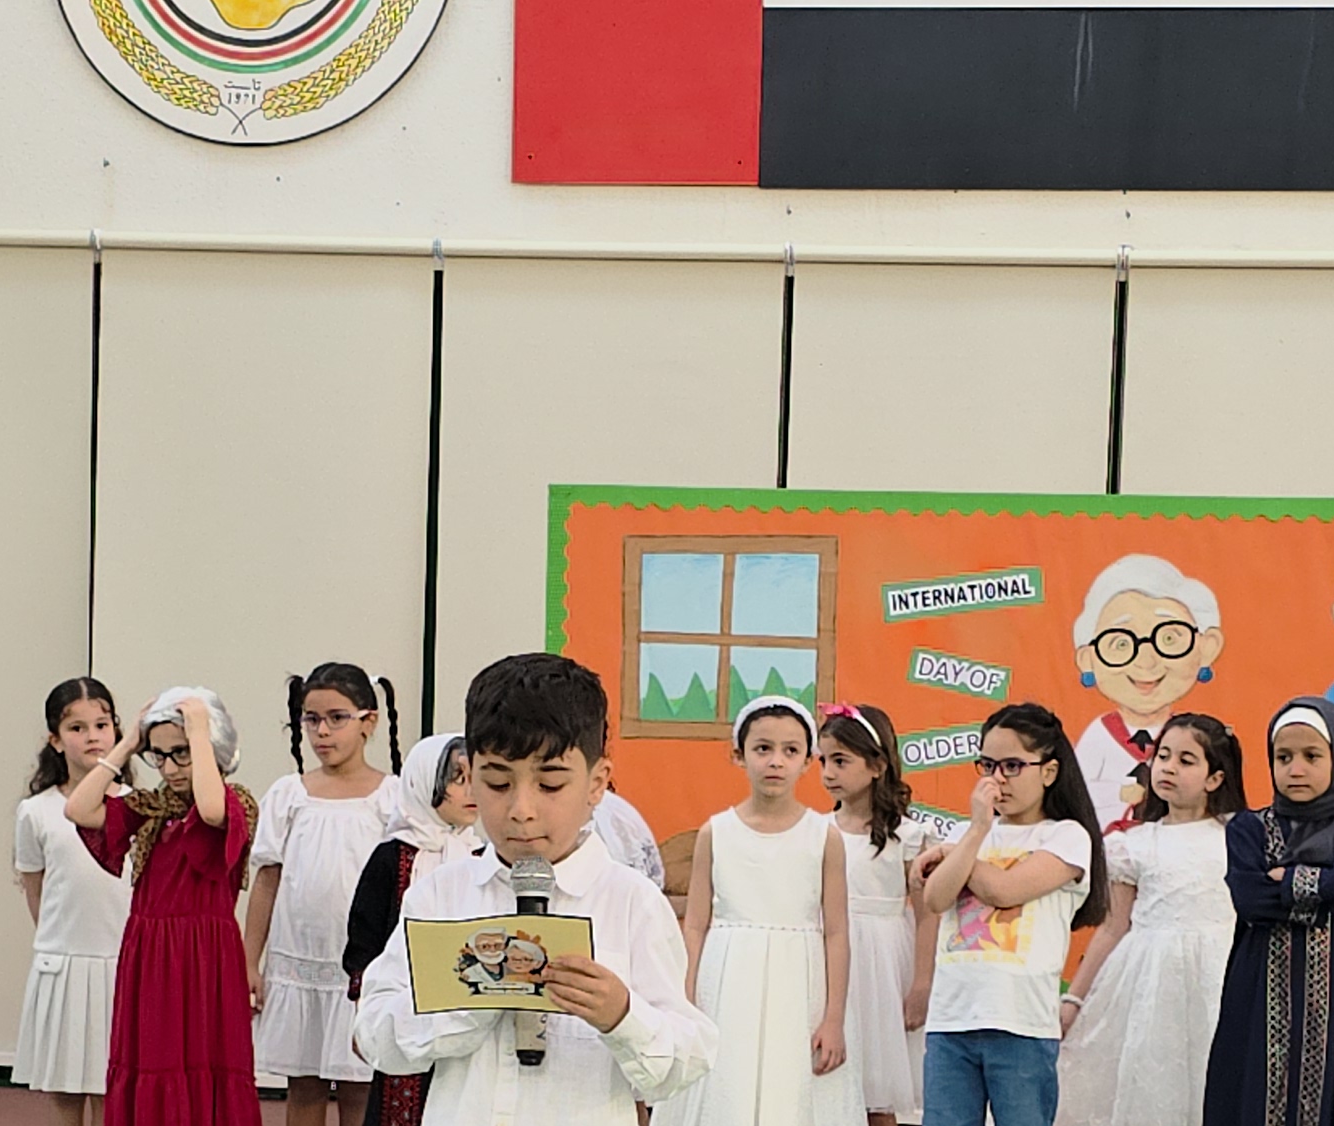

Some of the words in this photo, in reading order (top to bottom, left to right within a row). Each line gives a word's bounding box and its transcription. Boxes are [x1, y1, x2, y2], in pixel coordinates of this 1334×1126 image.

[891, 577, 1032, 612] INTERNATIONAL
[918, 656, 964, 683] DAY
[969, 668, 1002, 692] OF
[904, 733, 982, 763] OLDER
